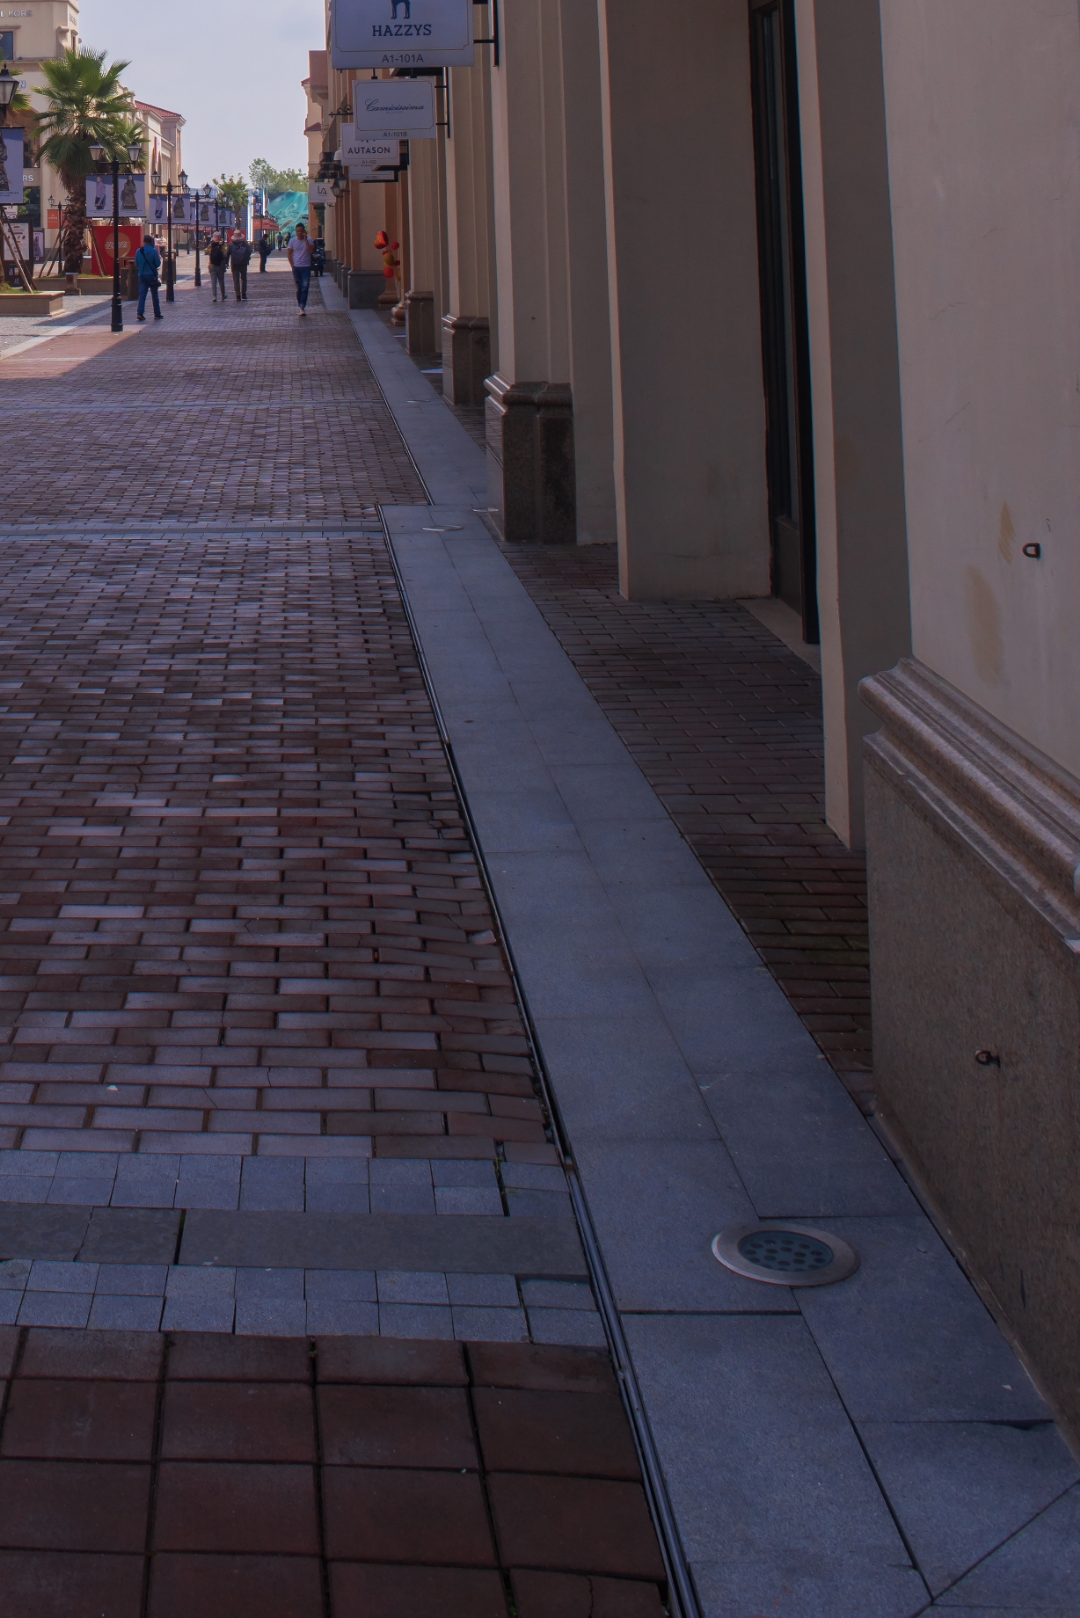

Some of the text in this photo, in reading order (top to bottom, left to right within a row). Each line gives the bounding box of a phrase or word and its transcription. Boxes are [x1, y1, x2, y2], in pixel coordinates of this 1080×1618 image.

[8, 9, 33, 18] KORS
[372, 24, 432, 37] HAZZYS
[382, 54, 424, 64] A1-101A
[365, 99, 424, 112] Camicissima
[347, 146, 391, 155] AUTASON
